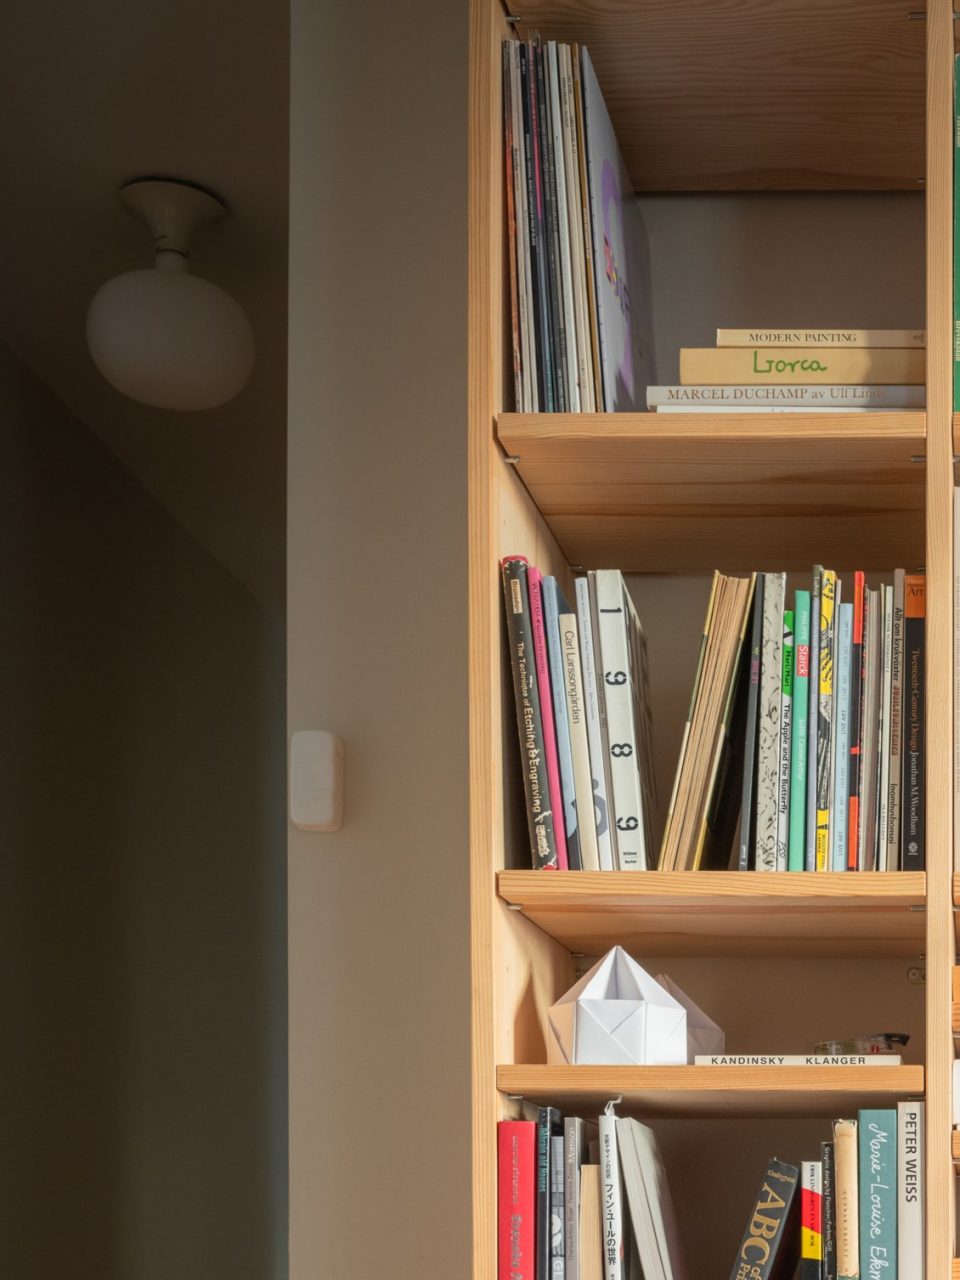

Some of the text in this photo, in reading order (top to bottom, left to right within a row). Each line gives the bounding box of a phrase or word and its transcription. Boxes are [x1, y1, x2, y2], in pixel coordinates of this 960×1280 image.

[749, 333, 857, 342] MODERN PAINTING
[753, 350, 828, 373] Lorca
[668, 388, 886, 399] MARCEL DUCHAMP av Ulf Linde
[894, 623, 900, 637] om
[895, 608, 903, 622] Allt
[517, 642, 525, 656] The
[798, 645, 808, 675] Starck
[518, 658, 528, 697] Technique
[564, 631, 582, 724] Carl Larssongården
[522, 698, 529, 706] of
[523, 708, 536, 748] Etching
[782, 721, 790, 746] Apple
[529, 759, 542, 813] Engraving
[910, 723, 919, 835] Design Jonathan Woodham
[780, 779, 789, 815] Butterfly
[906, 1113, 917, 1203] PETER WEISS
[871, 1124, 889, 1239] Marie-Louise
[741, 1182, 786, 1265] ABC
